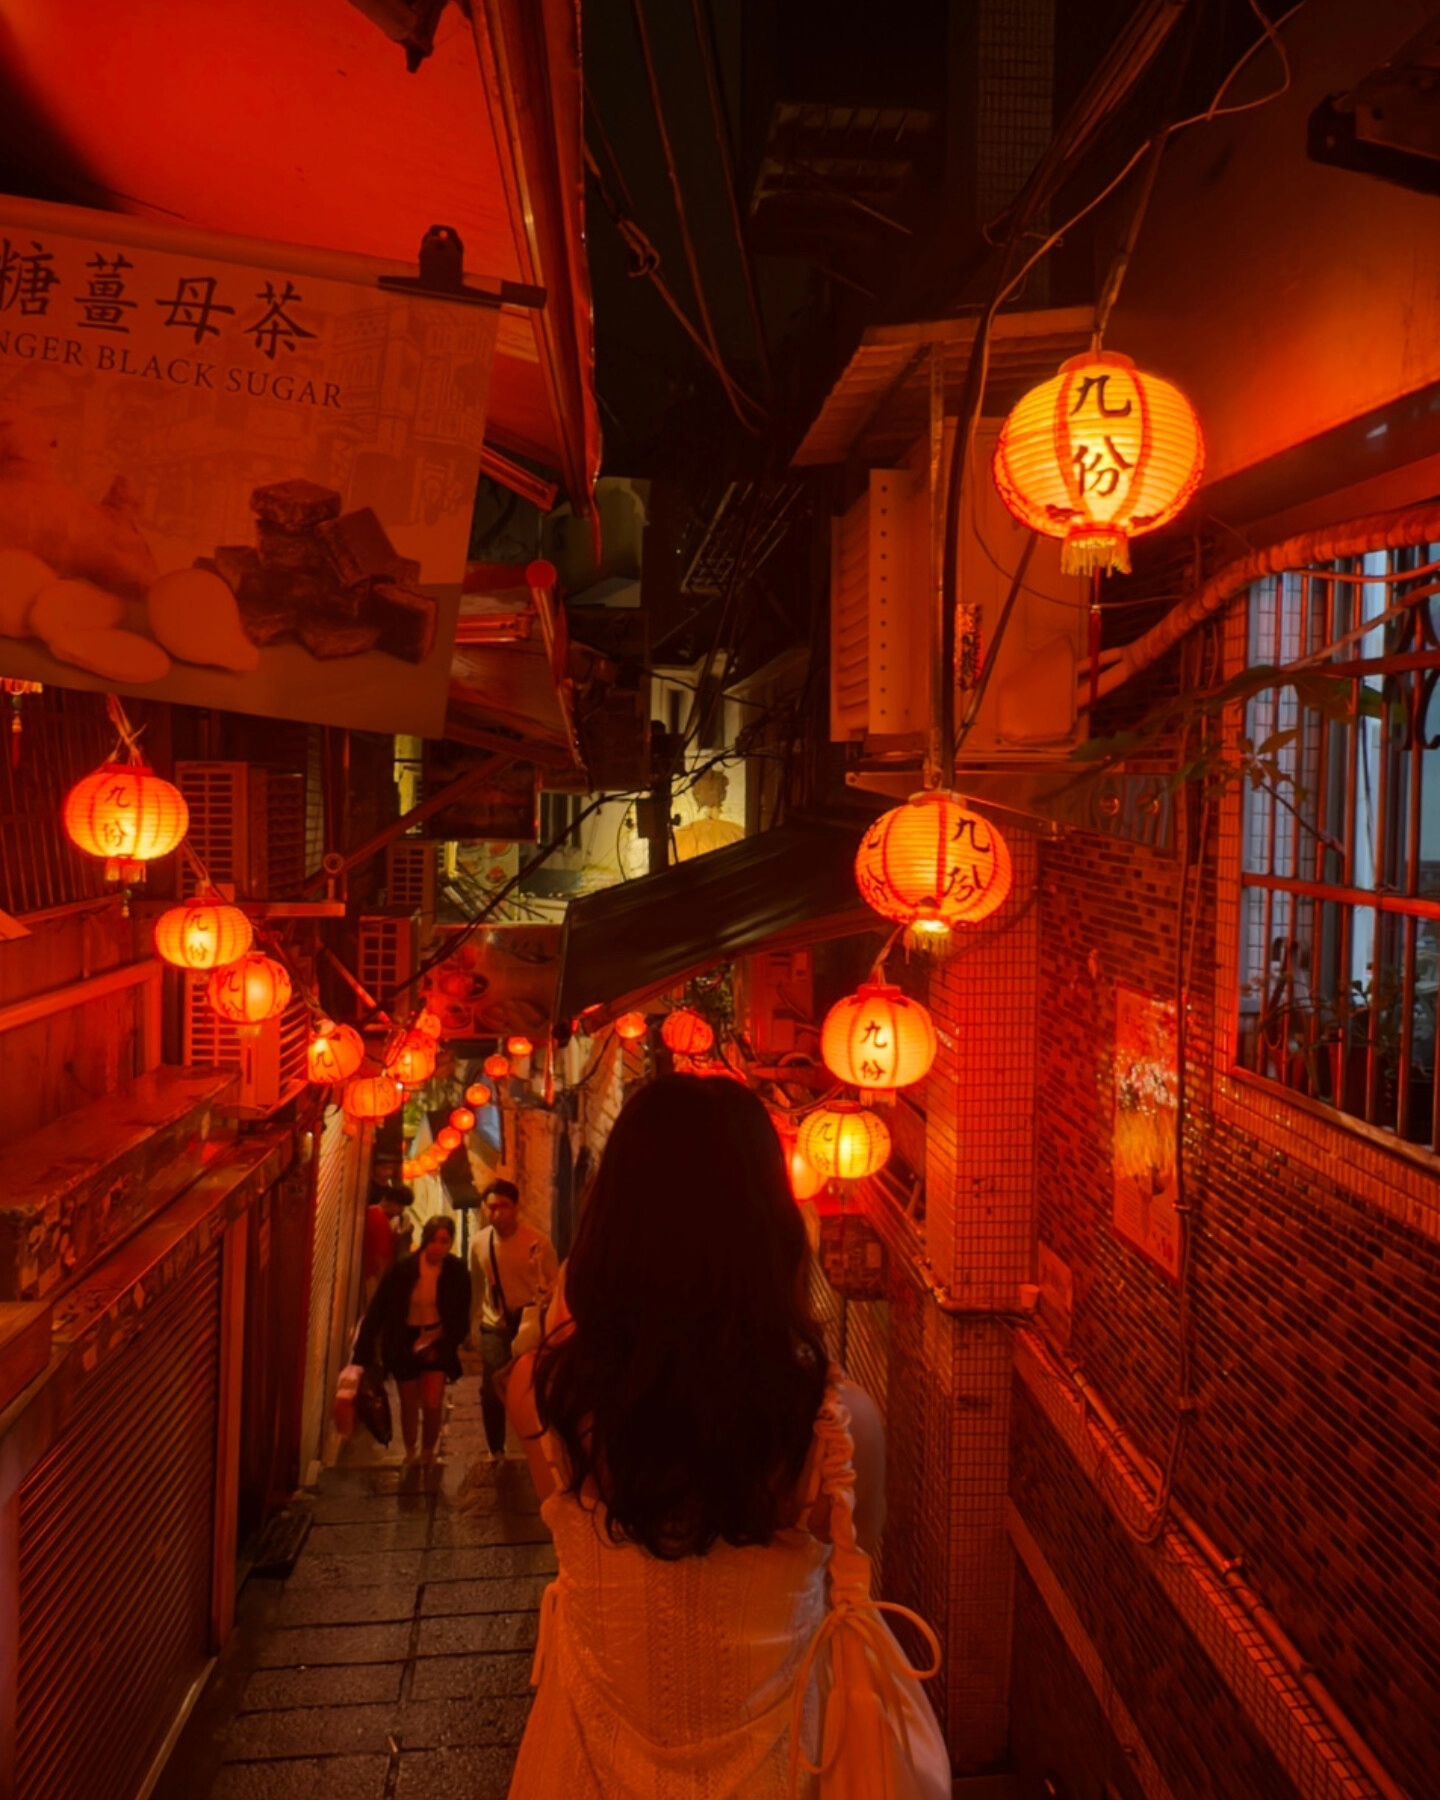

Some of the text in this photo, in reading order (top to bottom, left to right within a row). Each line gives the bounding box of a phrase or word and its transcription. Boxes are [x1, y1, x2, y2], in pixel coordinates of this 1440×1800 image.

[96, 344, 216, 389] BLACK
[226, 367, 342, 408] SUGAR
[1069, 374, 1135, 497] 九份
[943, 817, 991, 902] 九份
[859, 1020, 888, 1081] 九份
